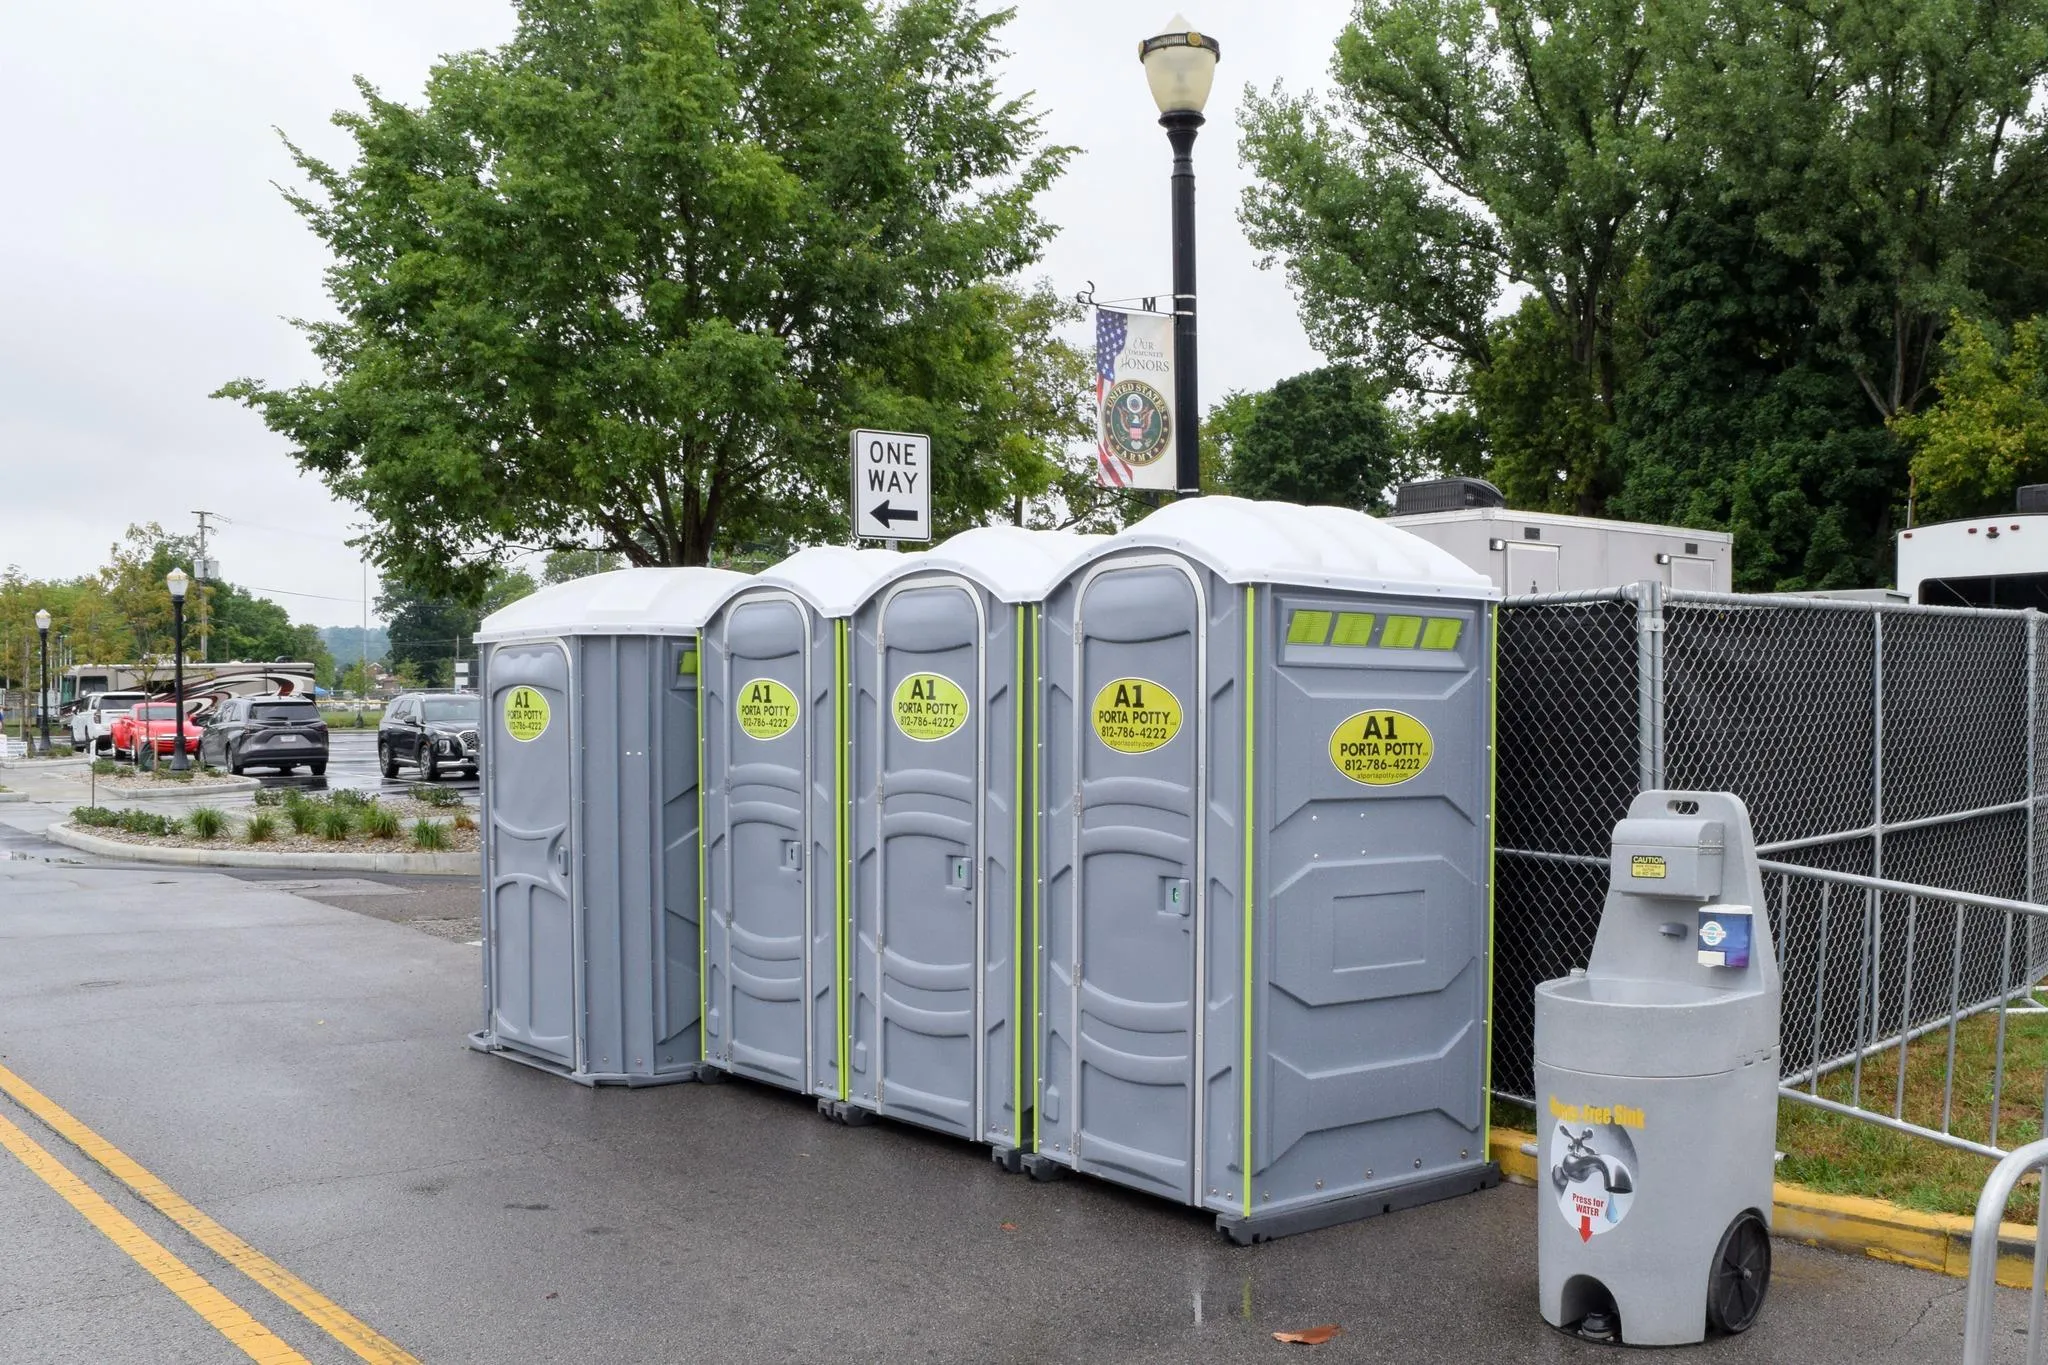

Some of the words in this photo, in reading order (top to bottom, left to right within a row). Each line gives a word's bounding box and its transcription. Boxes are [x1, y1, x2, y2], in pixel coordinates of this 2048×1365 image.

[1142, 297, 1156, 312] M
[1120, 356, 1170, 372] HONORS
[1107, 383, 1134, 408] UNITED
[1135, 383, 1166, 412] STATES
[870, 440, 916, 466] ONE
[1121, 450, 1153, 461] ARMY
[868, 469, 918, 494] WAY
[752, 684, 772, 703] A1
[911, 679, 936, 700] A1
[1114, 684, 1144, 708] A1
[515, 691, 530, 708] A1
[523, 710, 544, 720] POTTY
[742, 705, 761, 716] PORTA
[763, 705, 790, 716] POTTY
[899, 702, 922, 714] PORTA
[926, 703, 958, 715] POTTY
[901, 716, 955, 728] 812-786-4222
[1099, 710, 1128, 724] PORTA
[1132, 711, 1171, 725] POTTY
[1101, 726, 1167, 740] 812-786-4222
[1362, 716, 1398, 739] A1
[1340, 743, 1380, 756] PORTA
[1385, 742, 1423, 756] POTTY
[1344, 758, 1421, 771] 812-786-4222
[1633, 856, 1665, 864] CAUTION
[1614, 1104, 1645, 1129] Sink
[1572, 1192, 1592, 1206] Press
[1593, 1197, 1604, 1208] for
[1576, 1203, 1599, 1216] WATER
